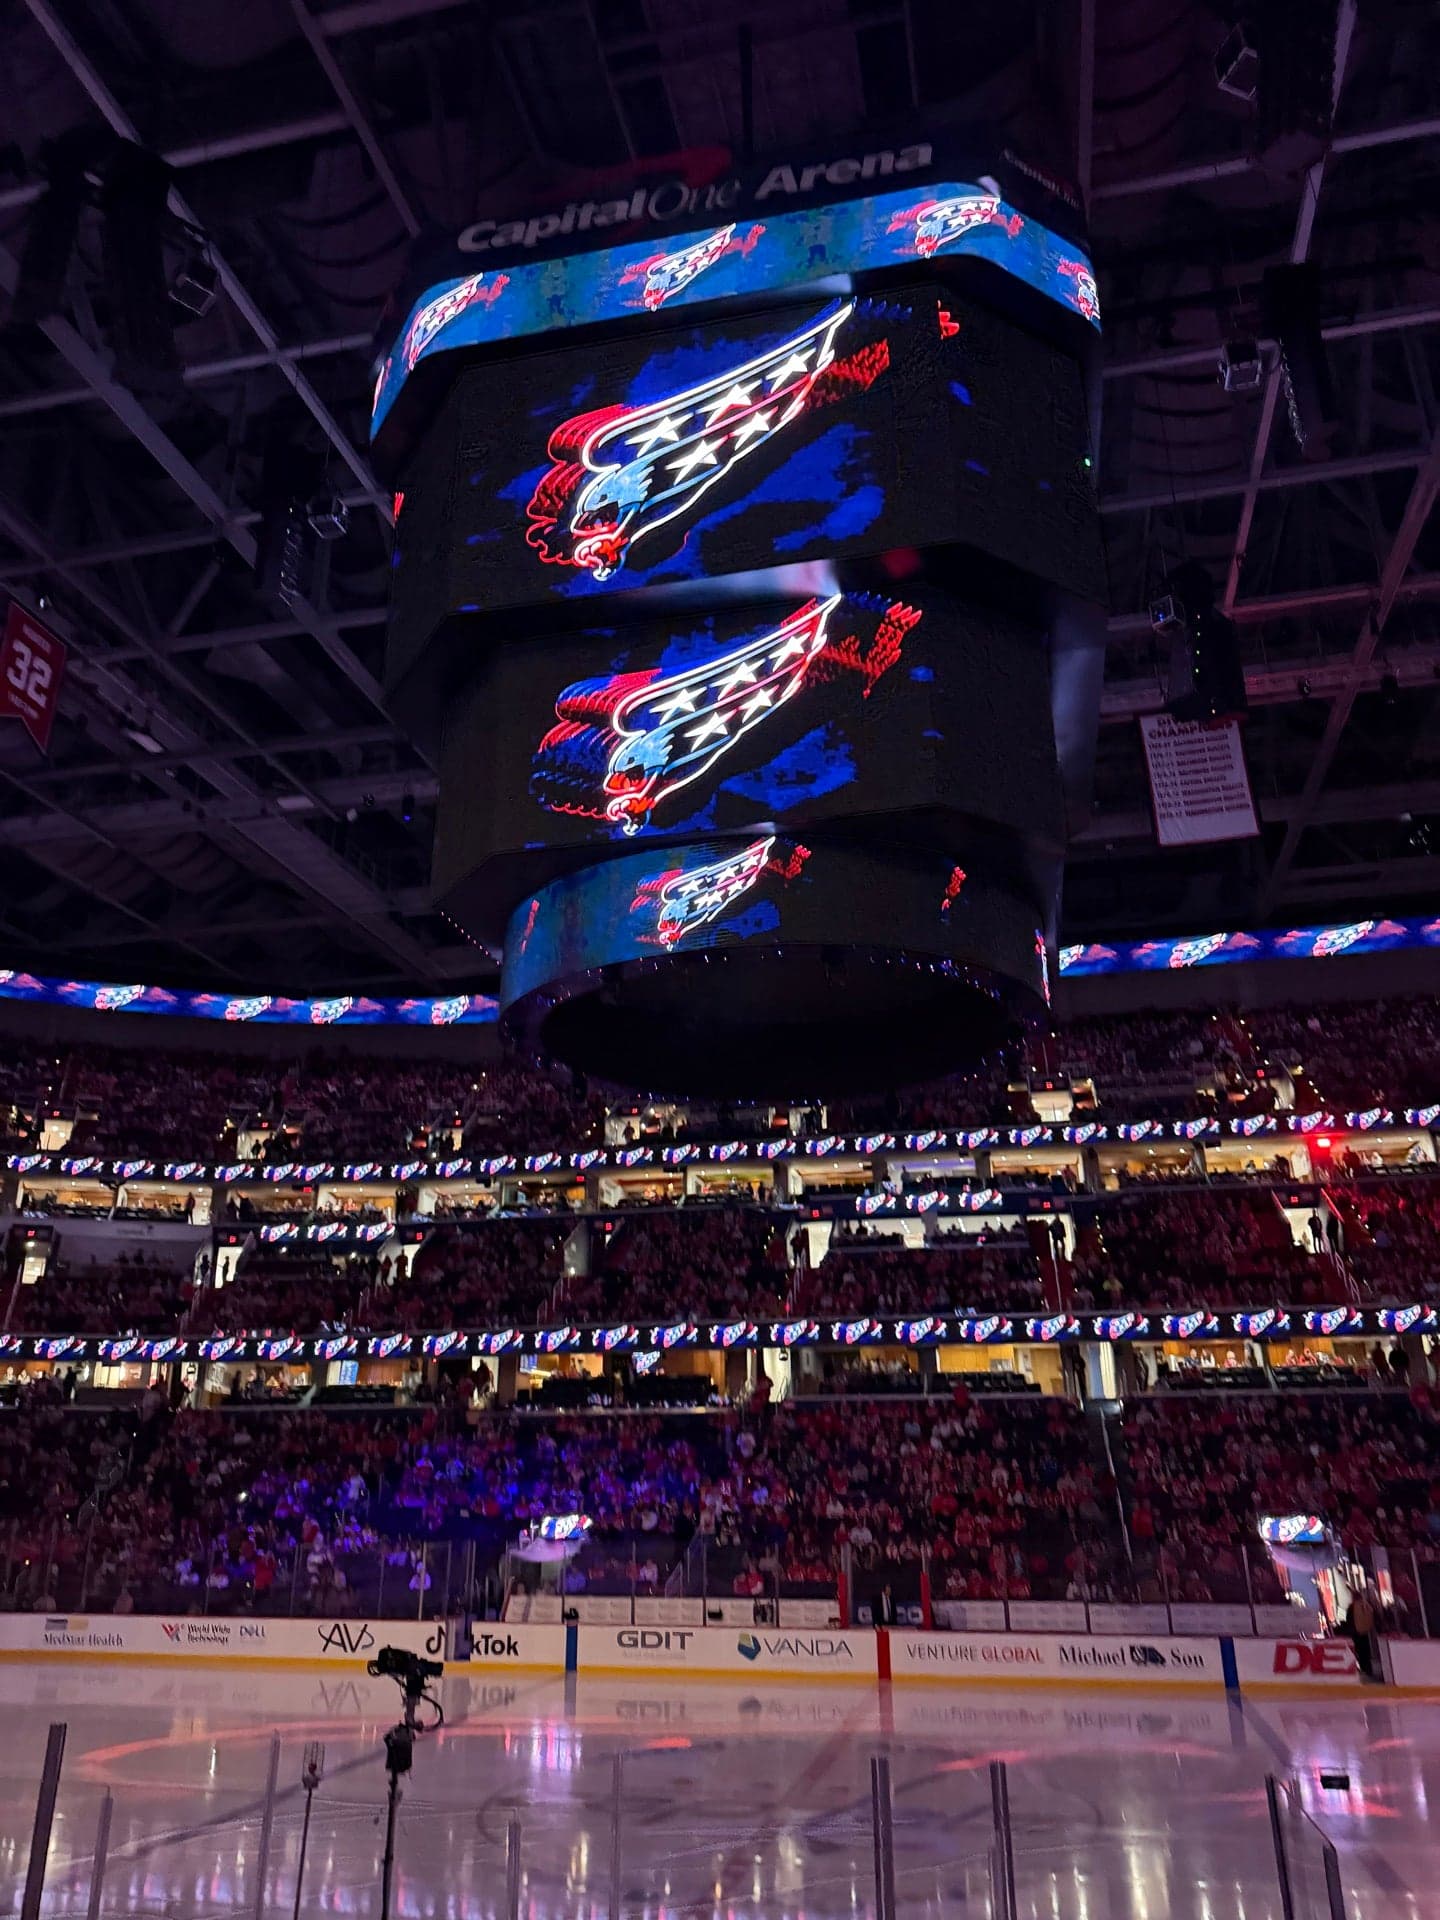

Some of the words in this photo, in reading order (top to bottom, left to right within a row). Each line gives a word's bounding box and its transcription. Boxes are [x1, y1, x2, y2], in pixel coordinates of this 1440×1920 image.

[755, 143, 932, 200] Arena
[7, 639, 52, 708] 32
[617, 1631, 693, 1650] GDIT
[764, 1638, 853, 1657] VANDA
[906, 1643, 978, 1662] VENTURE
[981, 1645, 1044, 1664] GLOBAL
[1059, 1645, 1126, 1666] Michael
[1170, 1648, 1205, 1668] Son
[1273, 1642, 1357, 1674] DE
